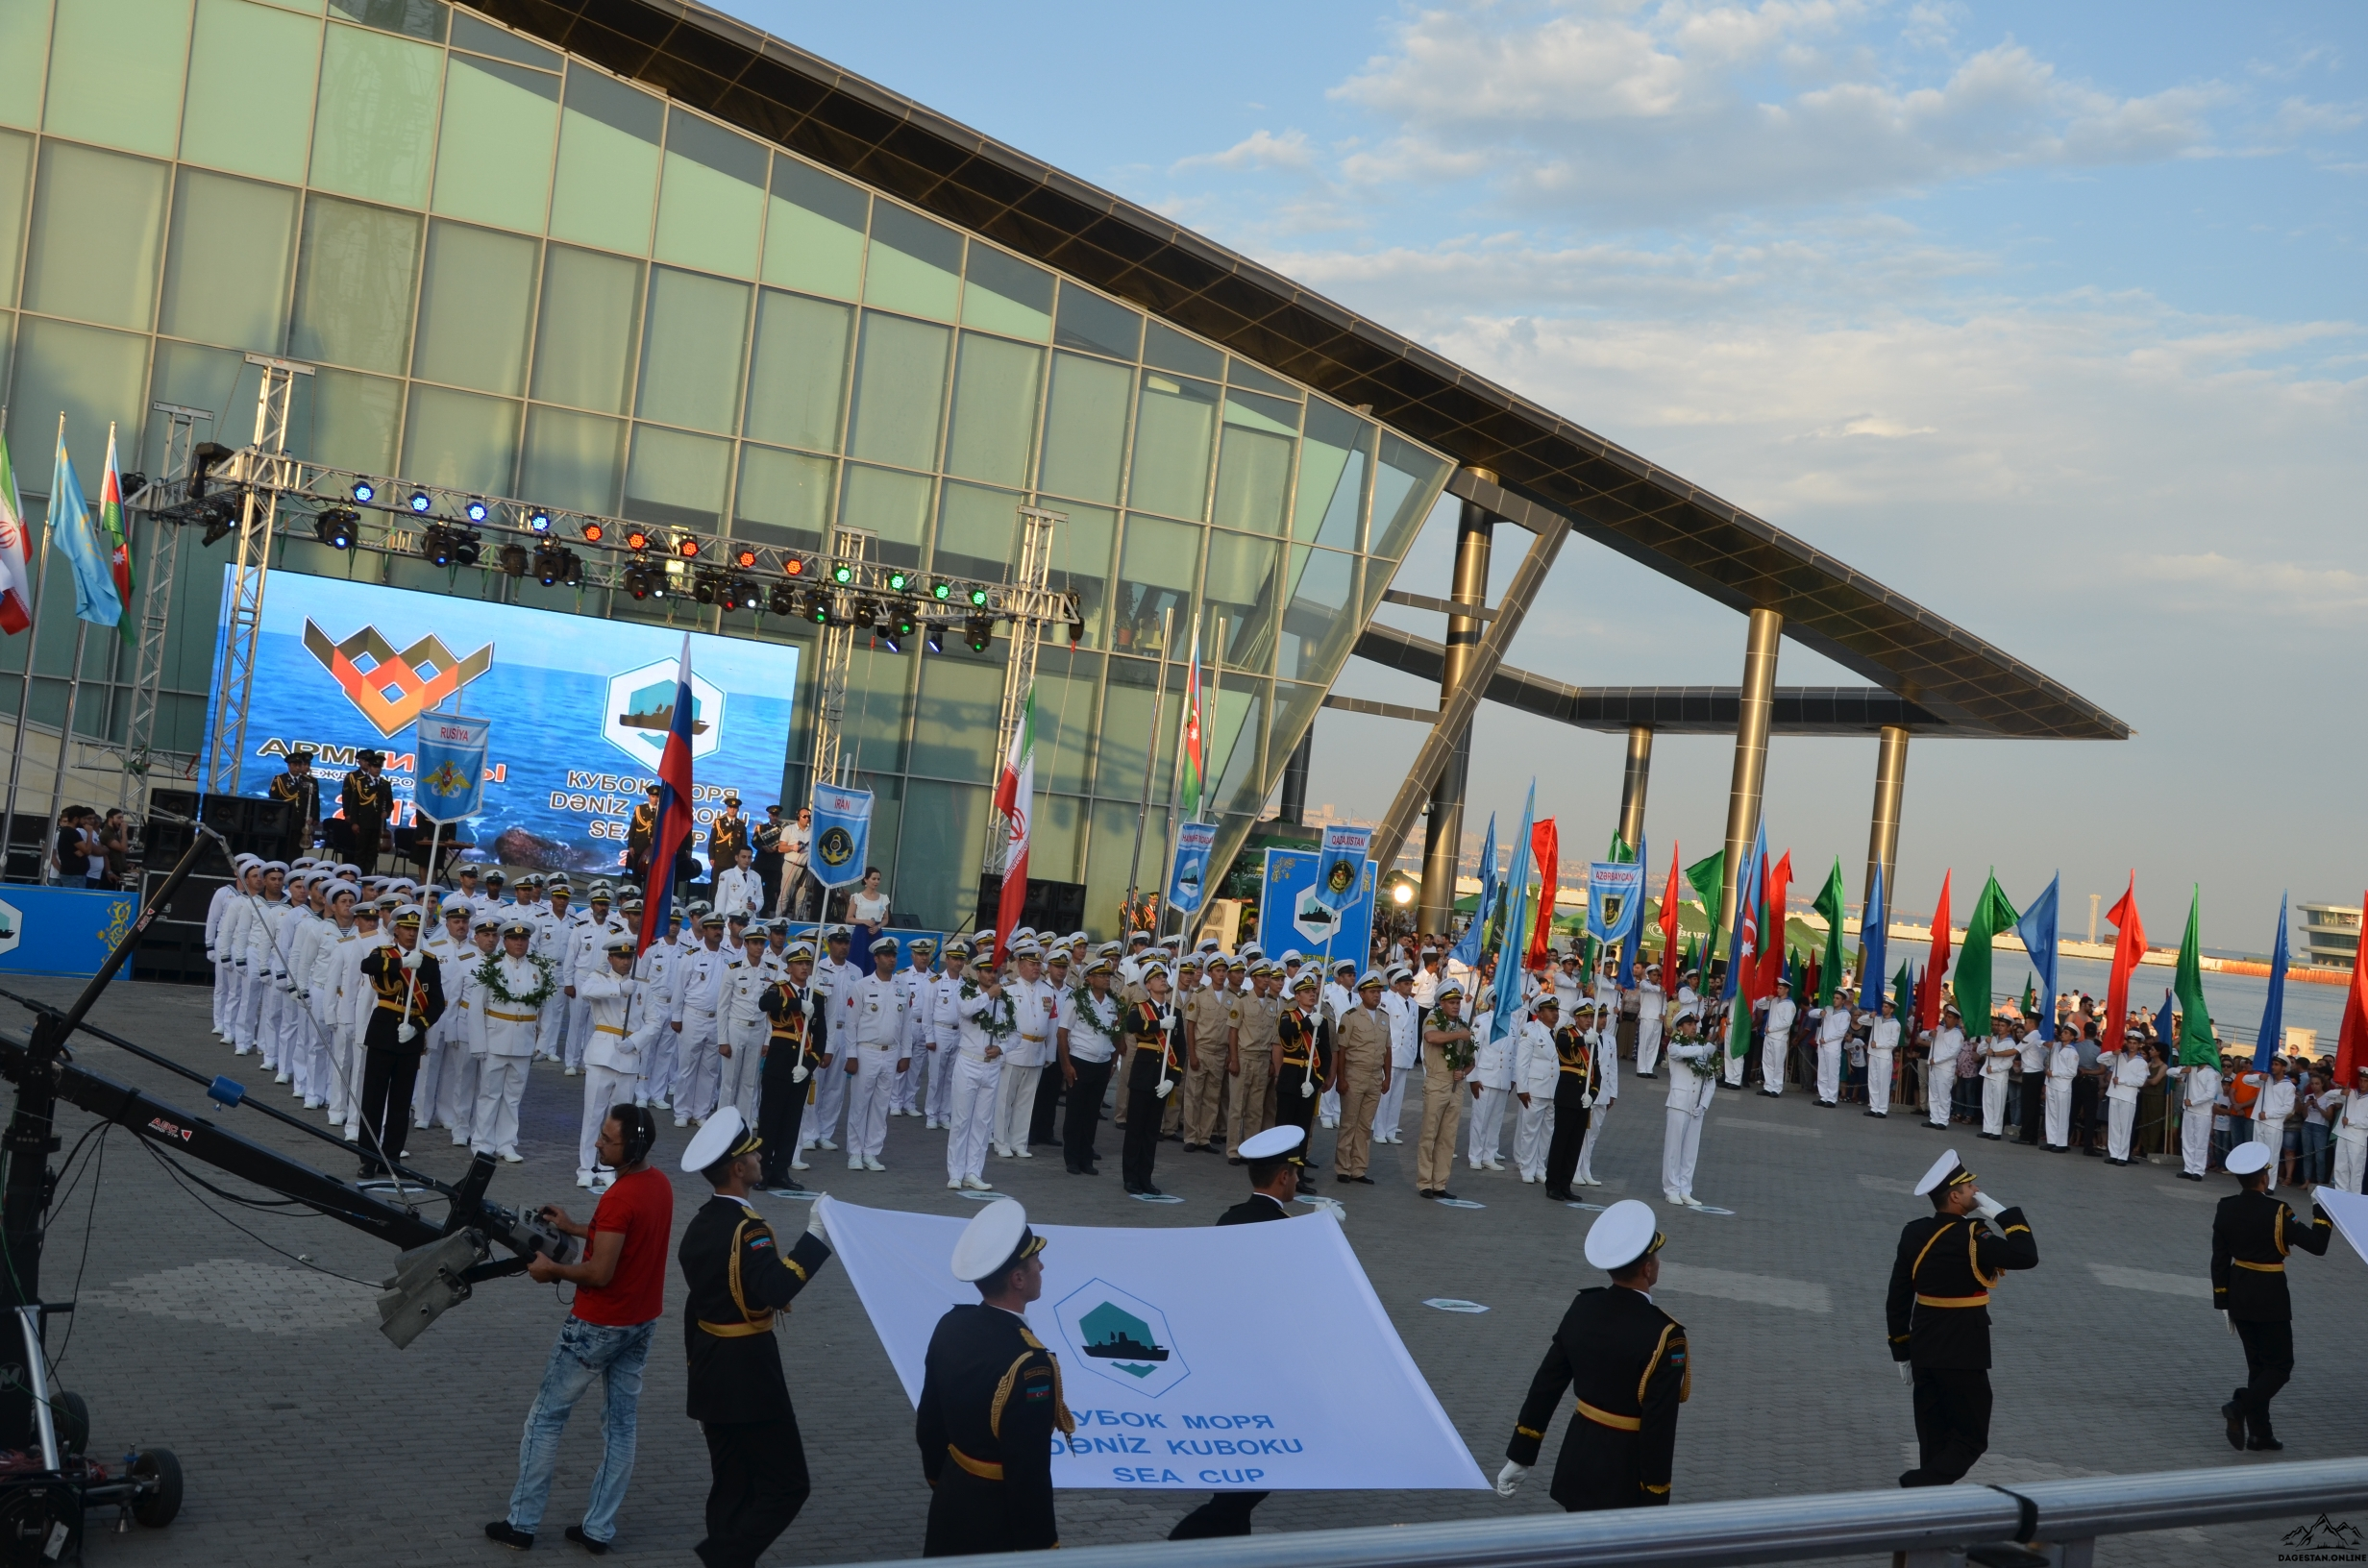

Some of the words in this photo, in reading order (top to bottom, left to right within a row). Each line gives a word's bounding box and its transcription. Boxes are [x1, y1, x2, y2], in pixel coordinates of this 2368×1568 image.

[440, 724, 469, 742] RUSİYA
[567, 770, 654, 796] КУБОК
[550, 792, 630, 817] DƏNİZ
[1595, 870, 1635, 882] AZƏRBAYCAN
[1070, 1410, 1168, 1429] УБОК
[1181, 1415, 1274, 1429] МОРЯ
[1167, 1439, 1303, 1455] KUBOKU
[1113, 1467, 1184, 1482] SEA
[1198, 1468, 1265, 1482] CUP
